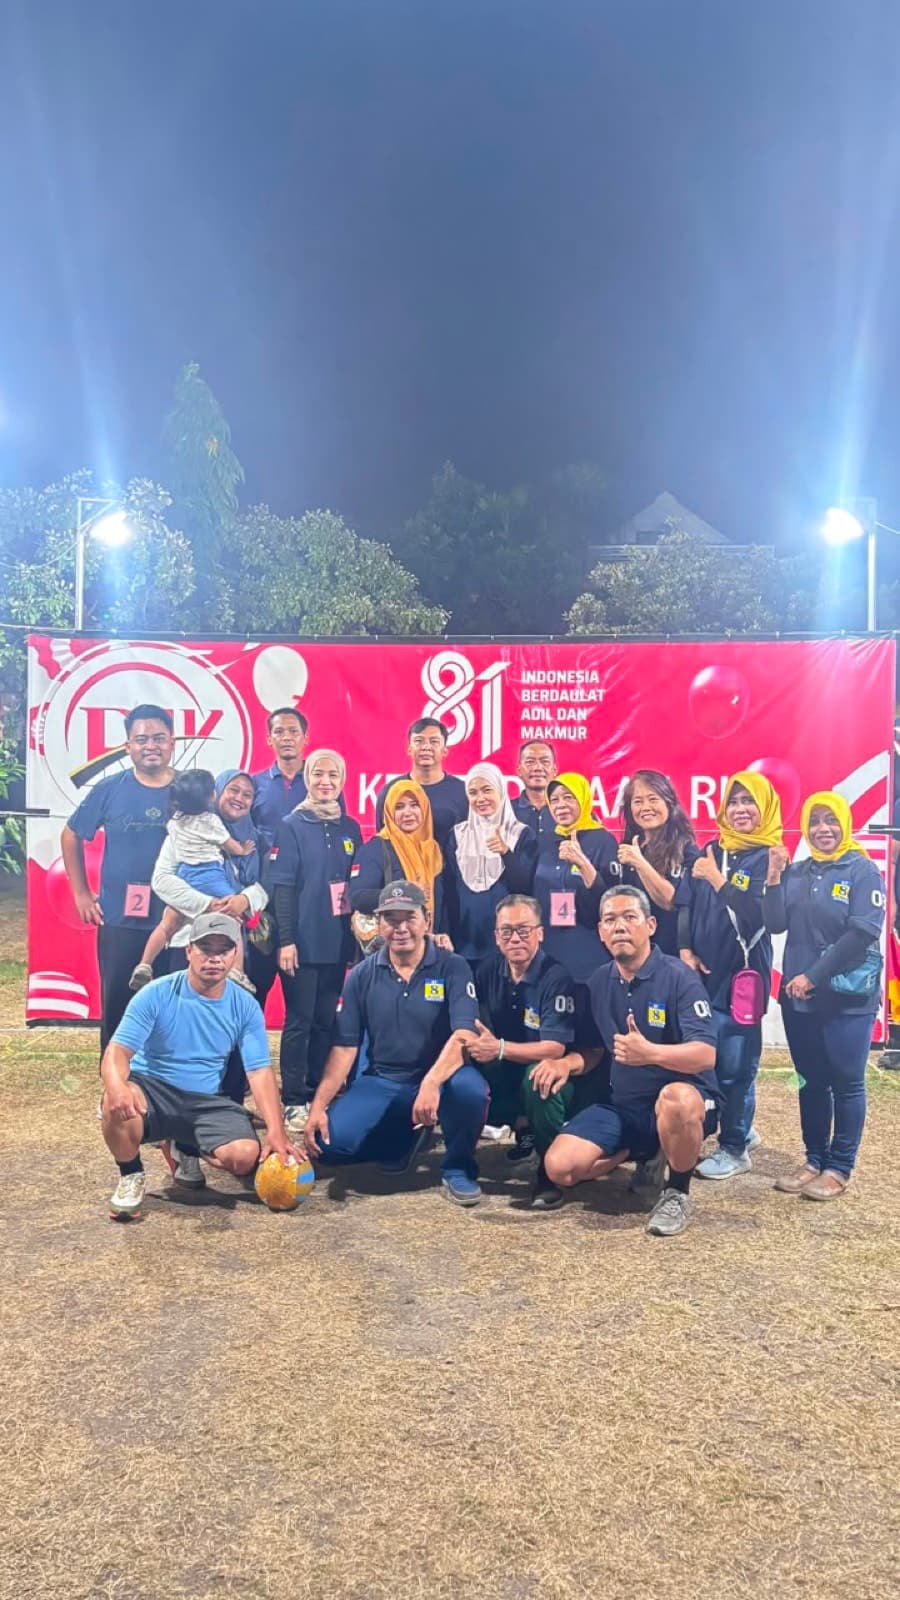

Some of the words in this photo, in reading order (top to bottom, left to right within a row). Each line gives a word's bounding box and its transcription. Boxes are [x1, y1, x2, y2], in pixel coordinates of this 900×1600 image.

[521, 670, 599, 684] INDONESIA
[521, 689, 606, 702] BERDAULAT
[421, 650, 512, 760] 81
[521, 707, 552, 721] ADIL
[557, 707, 588, 721] DAN
[521, 726, 588, 740] MAKMUR
[131, 893, 145, 912] 2
[557, 900, 570, 920] 4
